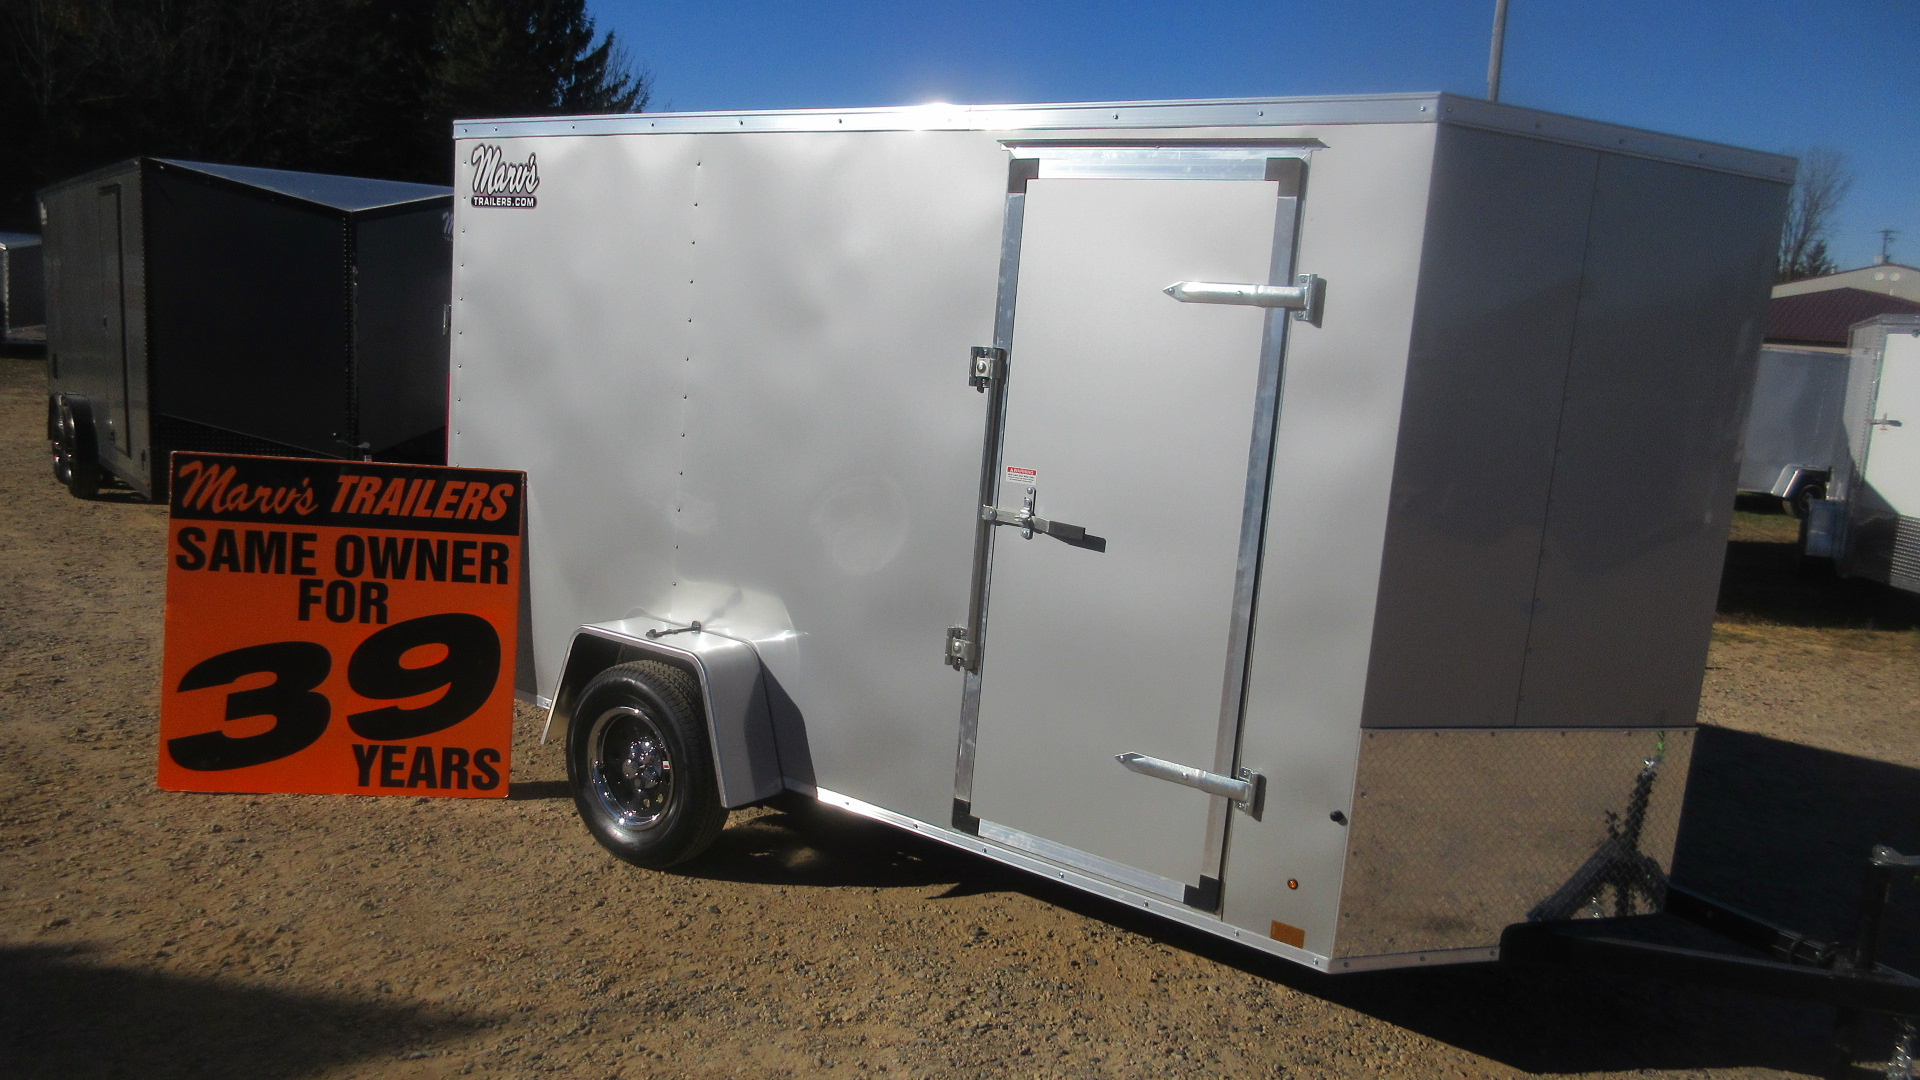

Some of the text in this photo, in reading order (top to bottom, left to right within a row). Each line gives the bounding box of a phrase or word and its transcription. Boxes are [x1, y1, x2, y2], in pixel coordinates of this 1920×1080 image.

[471, 143, 540, 195] Marv's
[473, 196, 534, 207] TRAILERS.COM
[178, 460, 515, 521] Marv's TRAILERS
[175, 527, 510, 585] SAME OWNER
[298, 579, 390, 624] FOR
[167, 612, 501, 771] 39
[352, 744, 501, 790] YEARS
